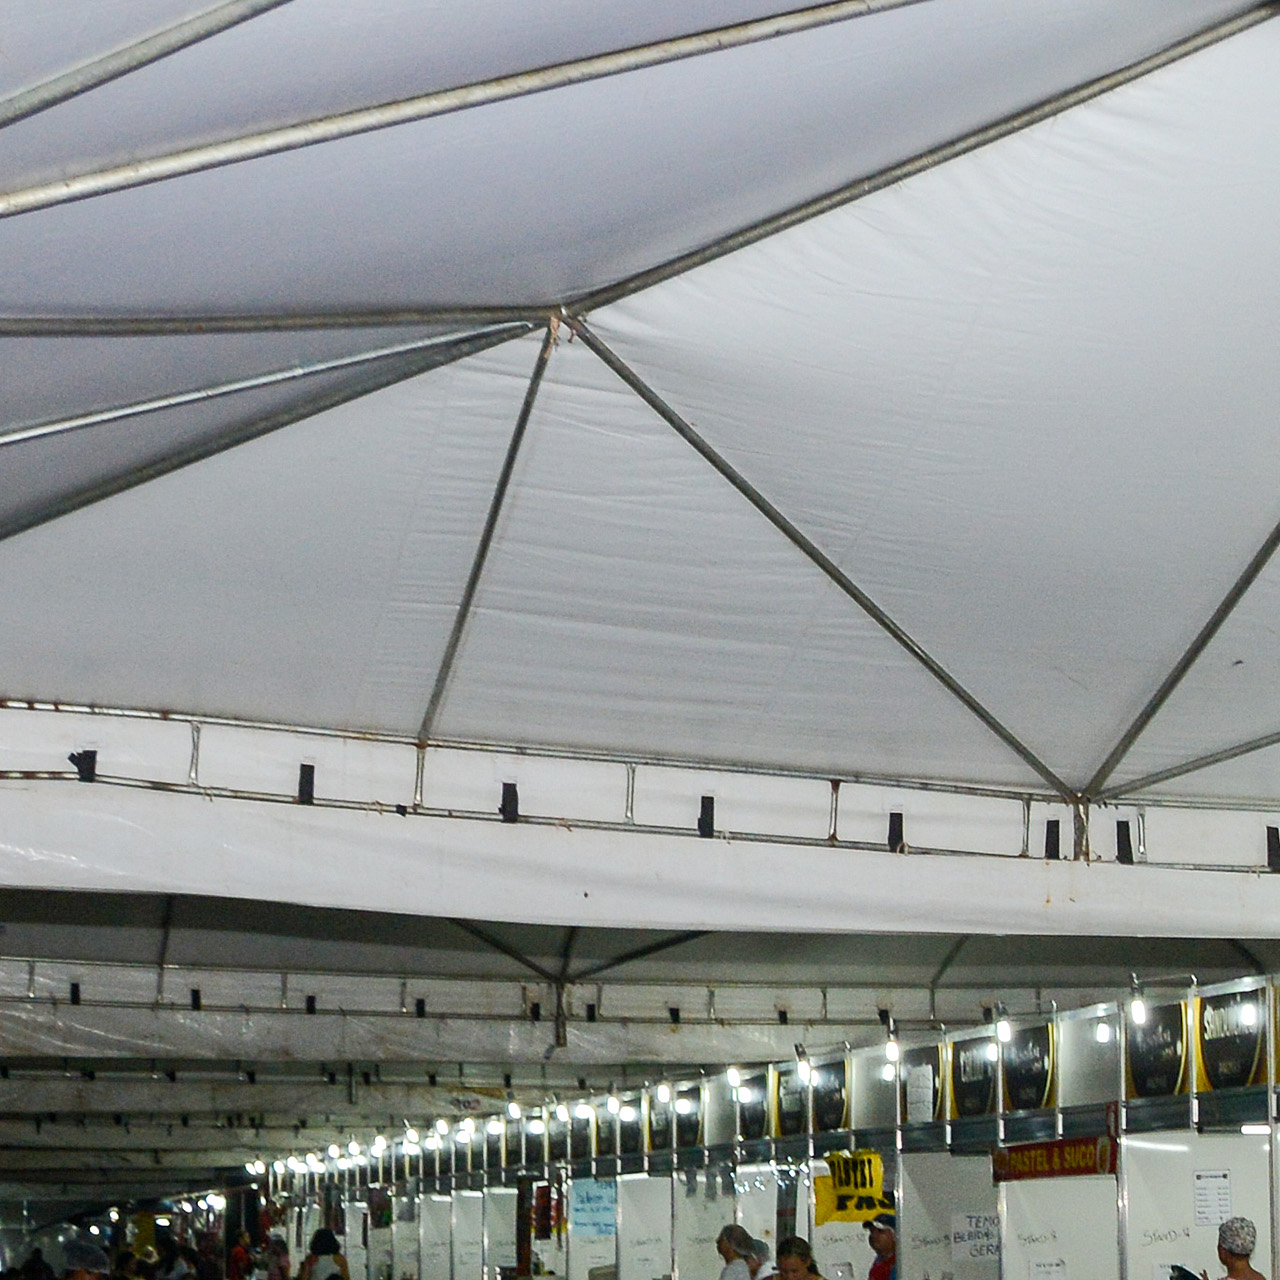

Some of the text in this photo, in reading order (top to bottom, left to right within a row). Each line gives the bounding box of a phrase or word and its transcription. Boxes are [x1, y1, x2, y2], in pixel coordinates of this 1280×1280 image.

[1009, 1145, 1095, 1173] PASTEL & SUCO
